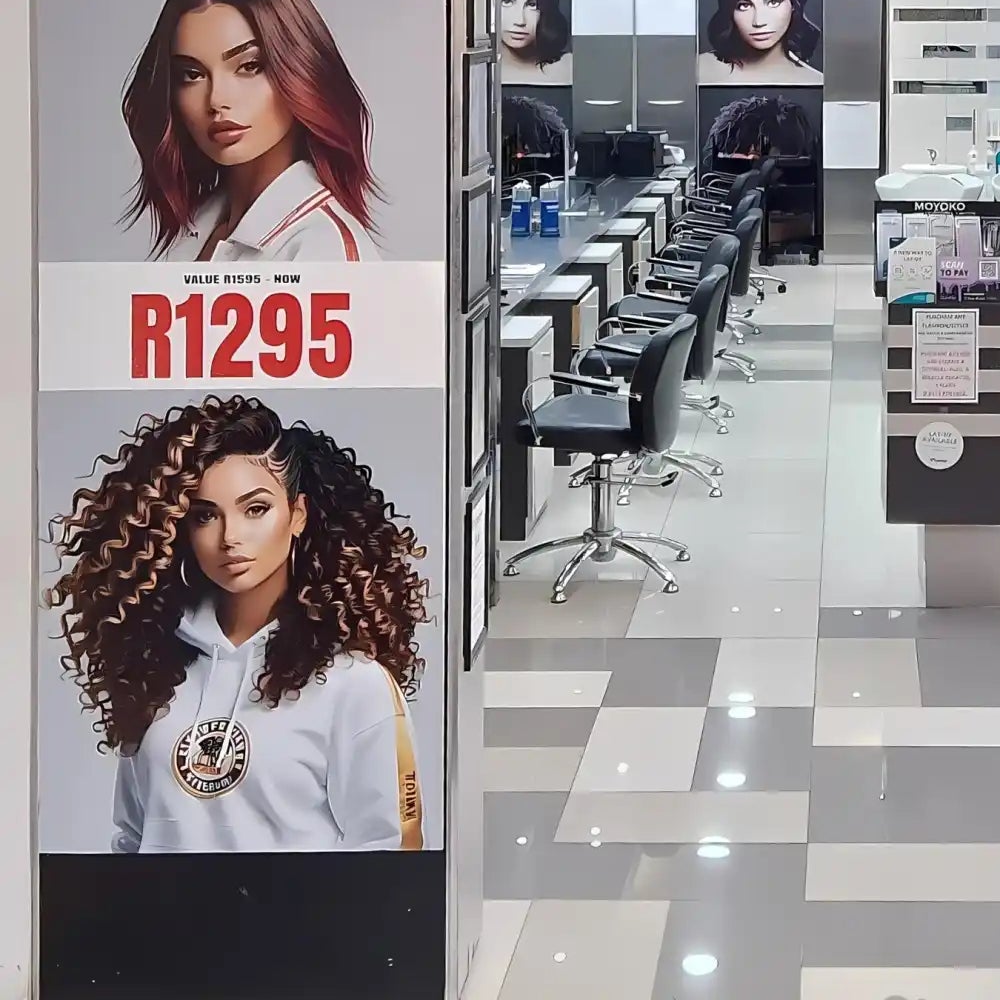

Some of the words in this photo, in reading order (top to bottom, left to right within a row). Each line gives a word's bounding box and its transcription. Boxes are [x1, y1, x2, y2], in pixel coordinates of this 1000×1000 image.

[914, 202, 966, 213] MOYOKO
[184, 274, 220, 285] VALUE
[224, 275, 261, 285] R1595
[274, 275, 301, 285] NOW
[131, 293, 352, 379] R1295
